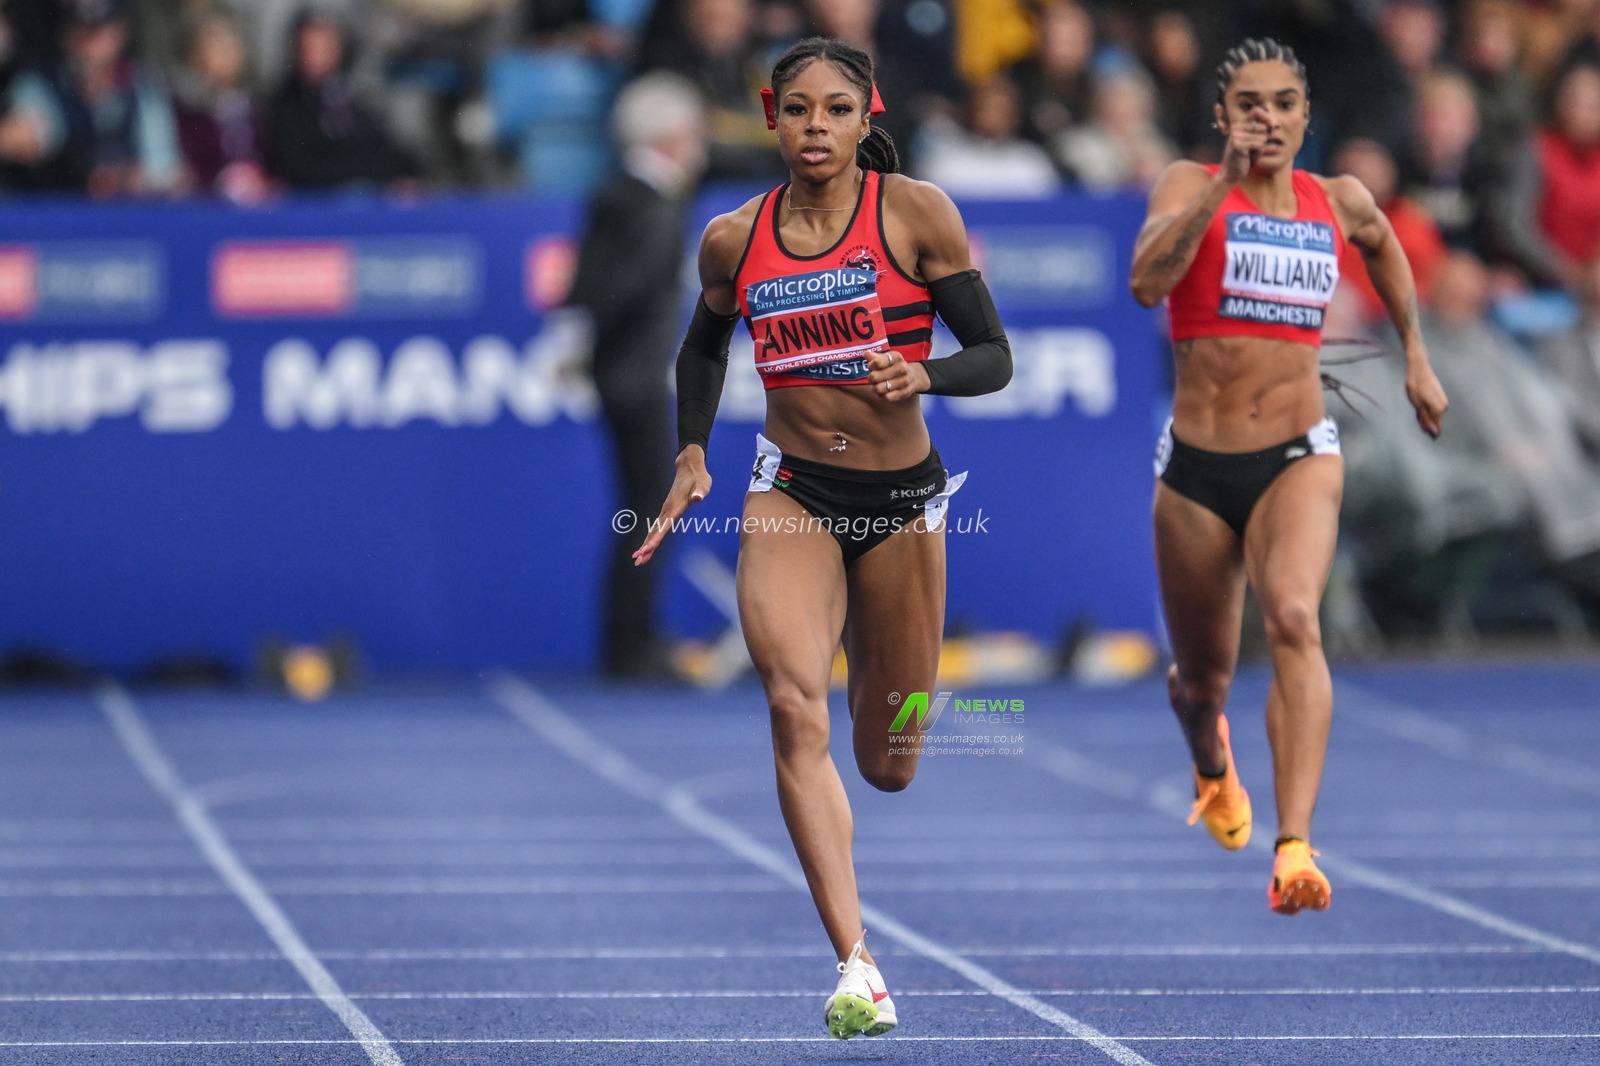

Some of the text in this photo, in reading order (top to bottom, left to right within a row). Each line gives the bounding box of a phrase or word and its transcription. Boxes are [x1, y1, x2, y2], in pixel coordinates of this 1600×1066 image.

[1231, 214, 1332, 249] Microplus
[754, 269, 867, 304] Microplus
[1233, 251, 1333, 293] WILLIAMS
[756, 302, 774, 311] DATA
[776, 293, 825, 308] PROCESSING
[837, 285, 866, 296] TIMING
[761, 306, 875, 358] ANNING
[774, 358, 816, 372] ATHLETICS
[901, 482, 936, 498] KUKRI
